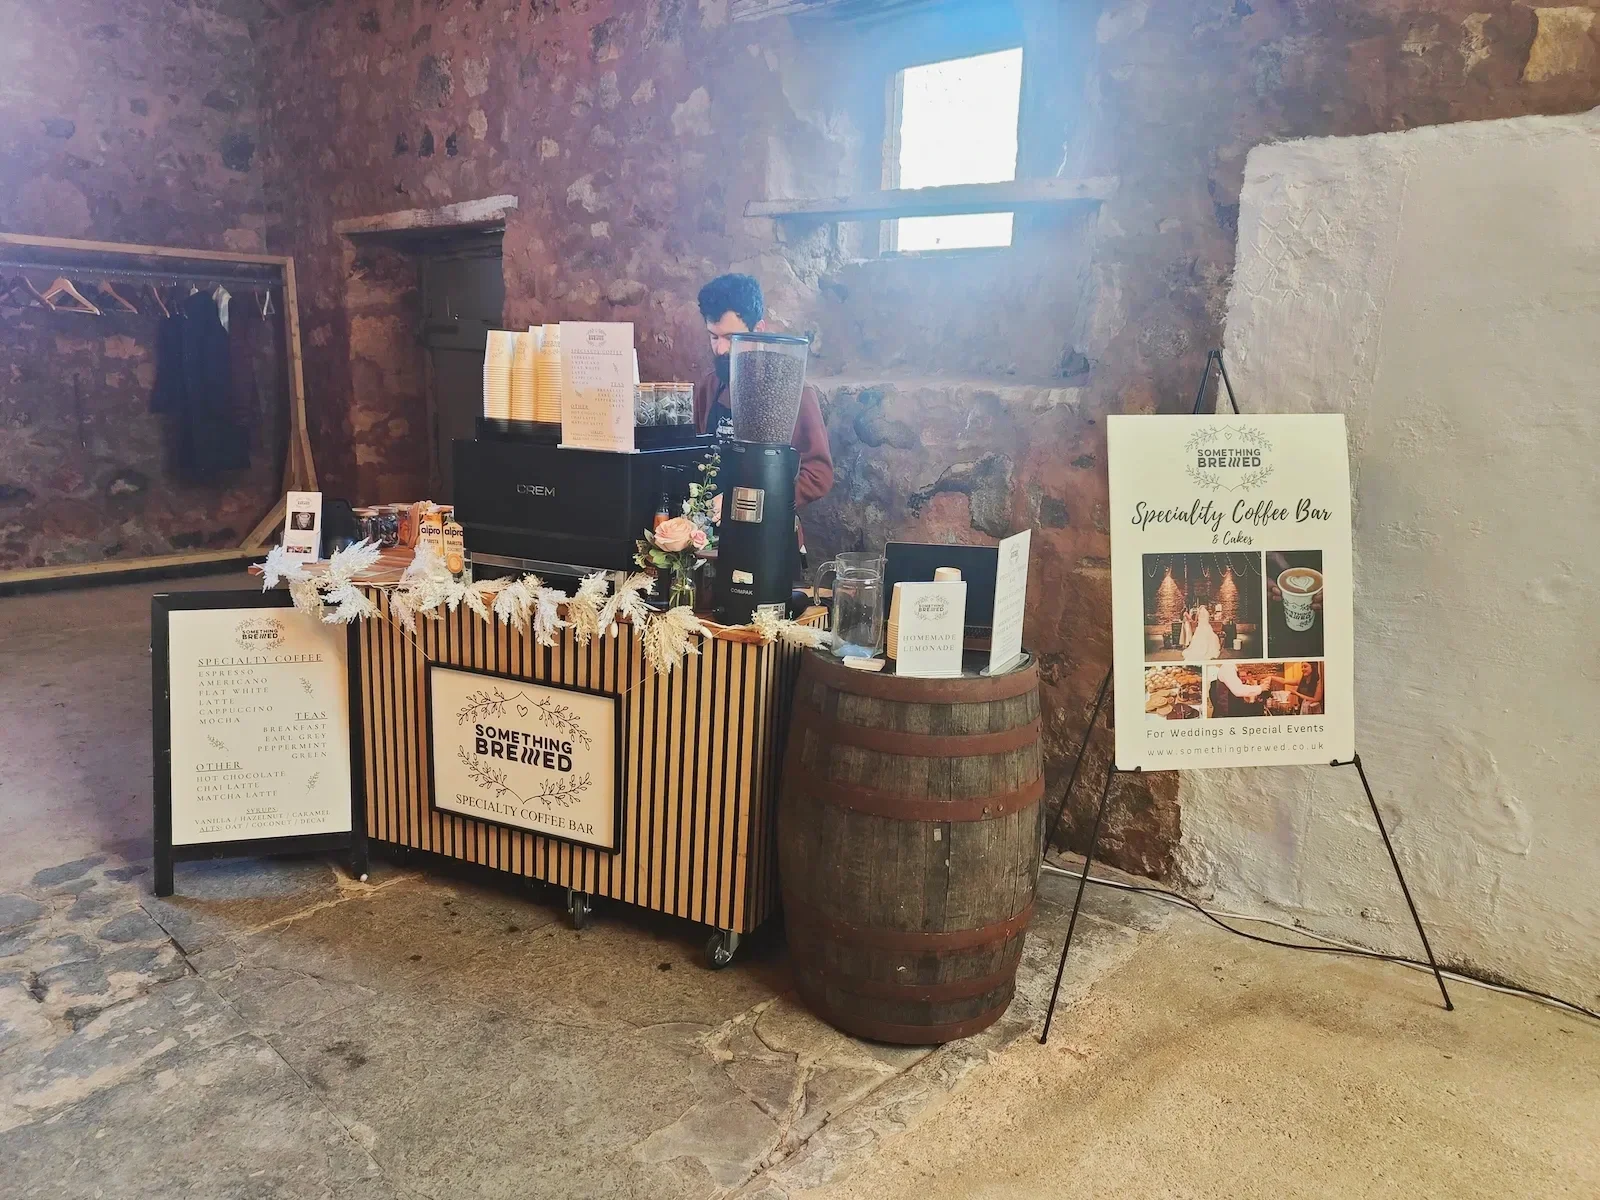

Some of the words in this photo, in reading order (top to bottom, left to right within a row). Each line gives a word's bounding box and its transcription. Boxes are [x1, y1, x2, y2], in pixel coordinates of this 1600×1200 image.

[1197, 448, 1261, 457] SOMETHING
[517, 484, 555, 497] CREM
[1132, 499, 1226, 532] Speciality
[1232, 499, 1289, 526] Coffee
[1296, 499, 1332, 523] Bar
[421, 525, 440, 536] alpro
[445, 527, 464, 538] alpro
[1212, 534, 1218, 544] &
[1223, 531, 1254, 546] Cakes
[198, 656, 269, 667] SPECIALTY
[274, 654, 323, 663] COFFEE
[199, 669, 254, 677] ESPRESSO
[199, 678, 268, 686] AMERICANO
[199, 706, 273, 715] CAPPUCCINO
[295, 712, 327, 720] TEAS
[263, 724, 327, 732] BREAKFAST
[1147, 729, 1165, 738] For
[1170, 727, 1224, 738] Weddings
[1242, 726, 1282, 735] Special
[1287, 724, 1324, 734] Events
[475, 724, 572, 754] SOMETHING
[258, 743, 326, 752] PEPPERMINT
[1148, 742, 1324, 756] www.somethingbrewed.co.uk
[196, 762, 242, 772] OTHER
[223, 771, 286, 781] CHOCOLATE
[197, 793, 241, 802] MATCHA
[240, 813, 283, 821] HAZELNUT
[455, 793, 518, 817] SPECIALTY
[520, 808, 566, 828] COFFEE
[568, 820, 594, 835] BAR
